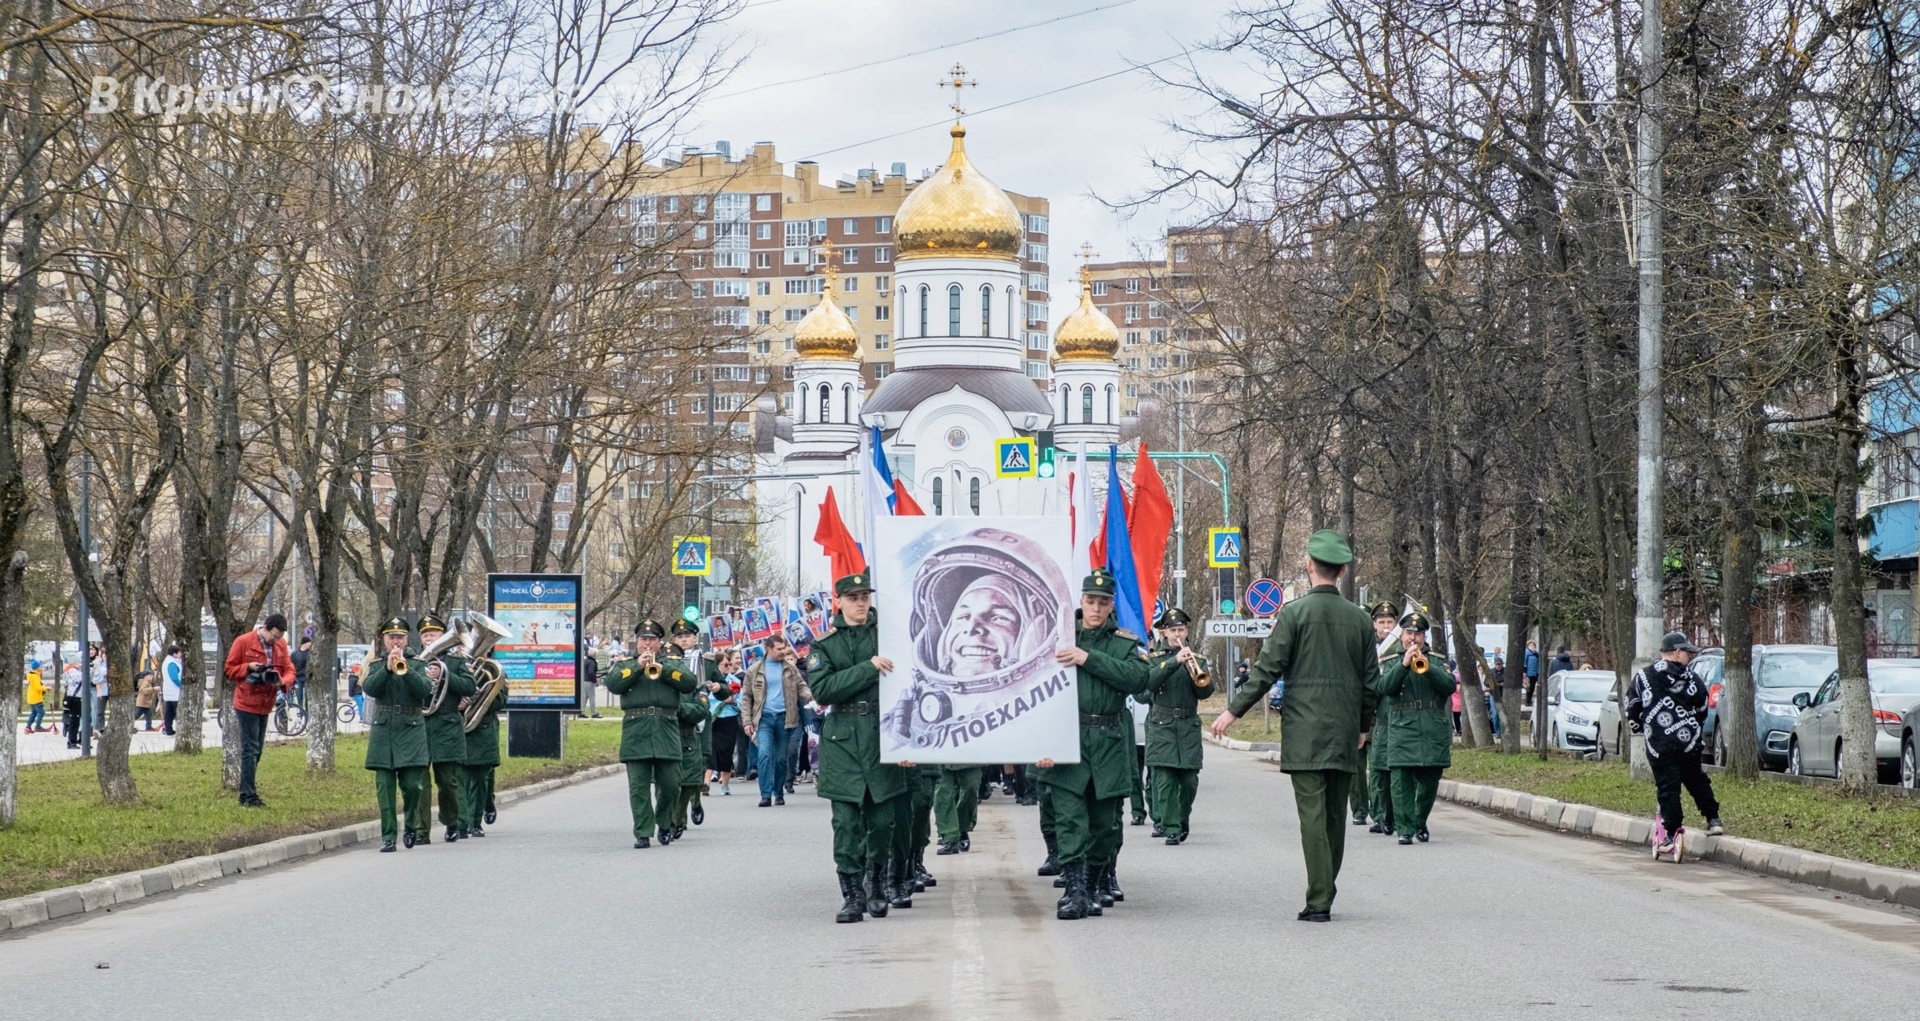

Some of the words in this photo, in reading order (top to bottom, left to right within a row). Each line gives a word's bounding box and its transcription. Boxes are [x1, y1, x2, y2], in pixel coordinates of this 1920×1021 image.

[545, 587, 569, 595] CLINIC
[1212, 623, 1246, 634] СТОП
[537, 667, 555, 675] ЛФК
[949, 669, 1071, 748] ПОЕХАЛИ!
